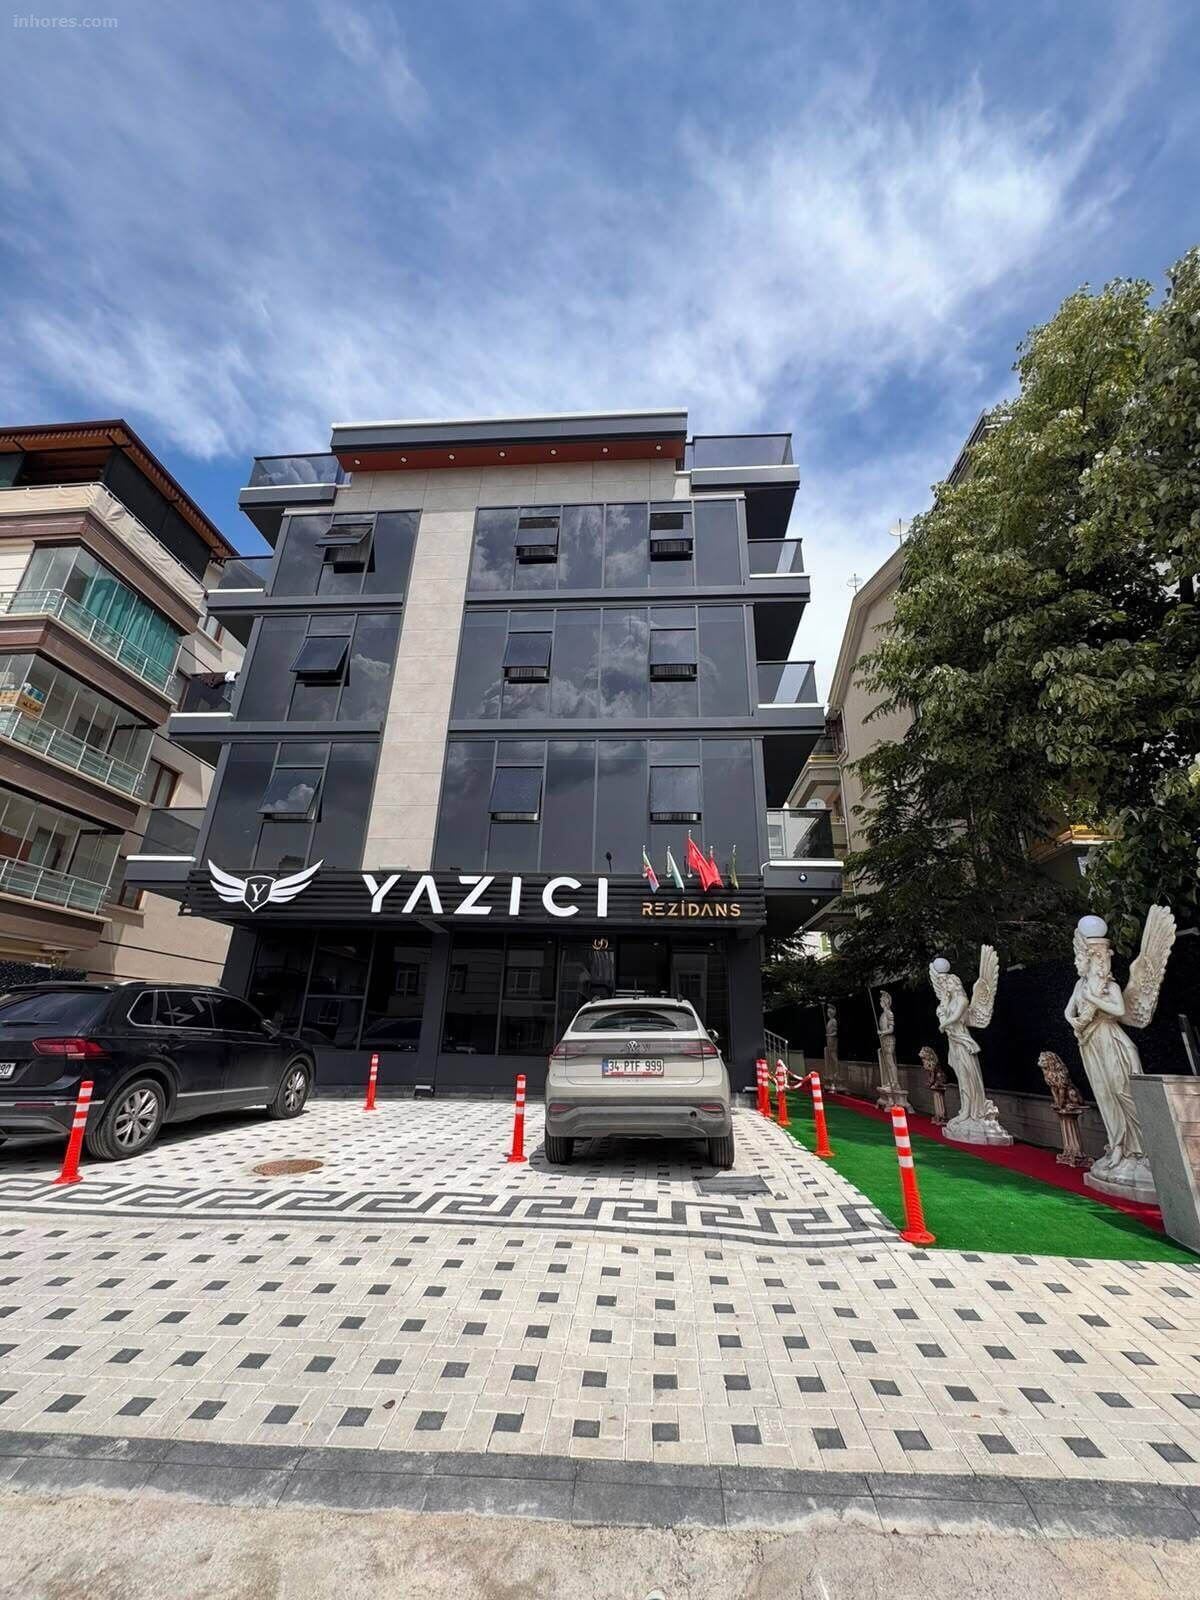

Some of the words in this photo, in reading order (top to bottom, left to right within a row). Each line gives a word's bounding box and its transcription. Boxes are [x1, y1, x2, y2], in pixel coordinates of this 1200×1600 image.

[250, 883, 268, 902] Y
[361, 874, 609, 918] YAZICI
[641, 900, 741, 917] REZİDANS
[0, 1064, 12, 1075] 90
[608, 1061, 620, 1072] 34
[624, 1061, 641, 1072] PTF
[645, 1061, 662, 1072] 999
